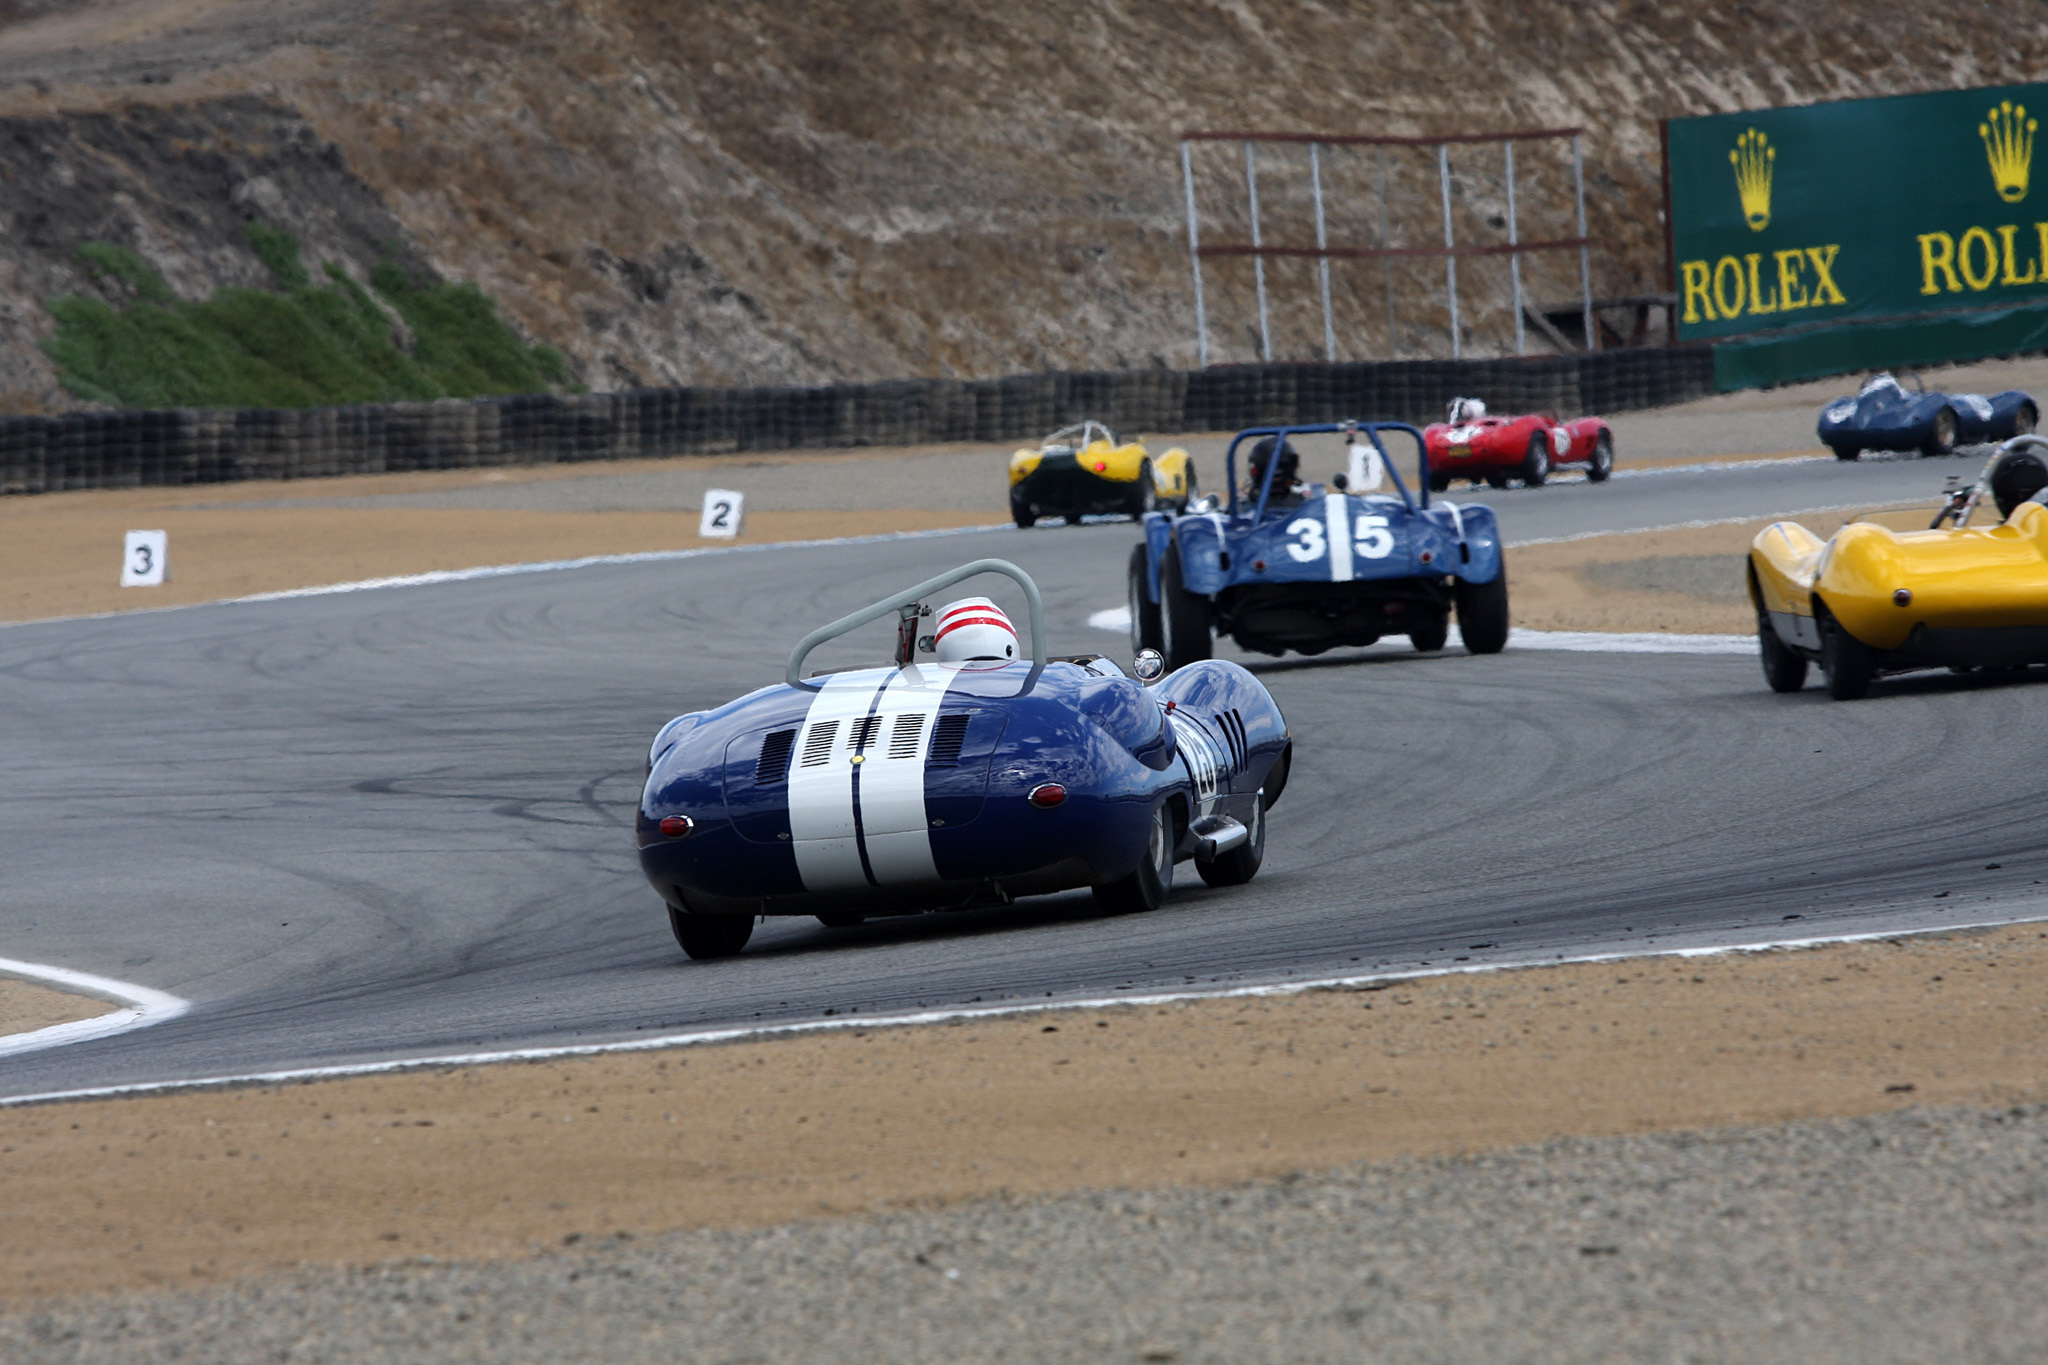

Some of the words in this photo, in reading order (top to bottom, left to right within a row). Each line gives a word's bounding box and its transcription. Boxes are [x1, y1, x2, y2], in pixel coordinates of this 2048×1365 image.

[1681, 243, 1847, 324] ROLEX
[711, 501, 731, 528] 2
[133, 544, 154, 575] 3
